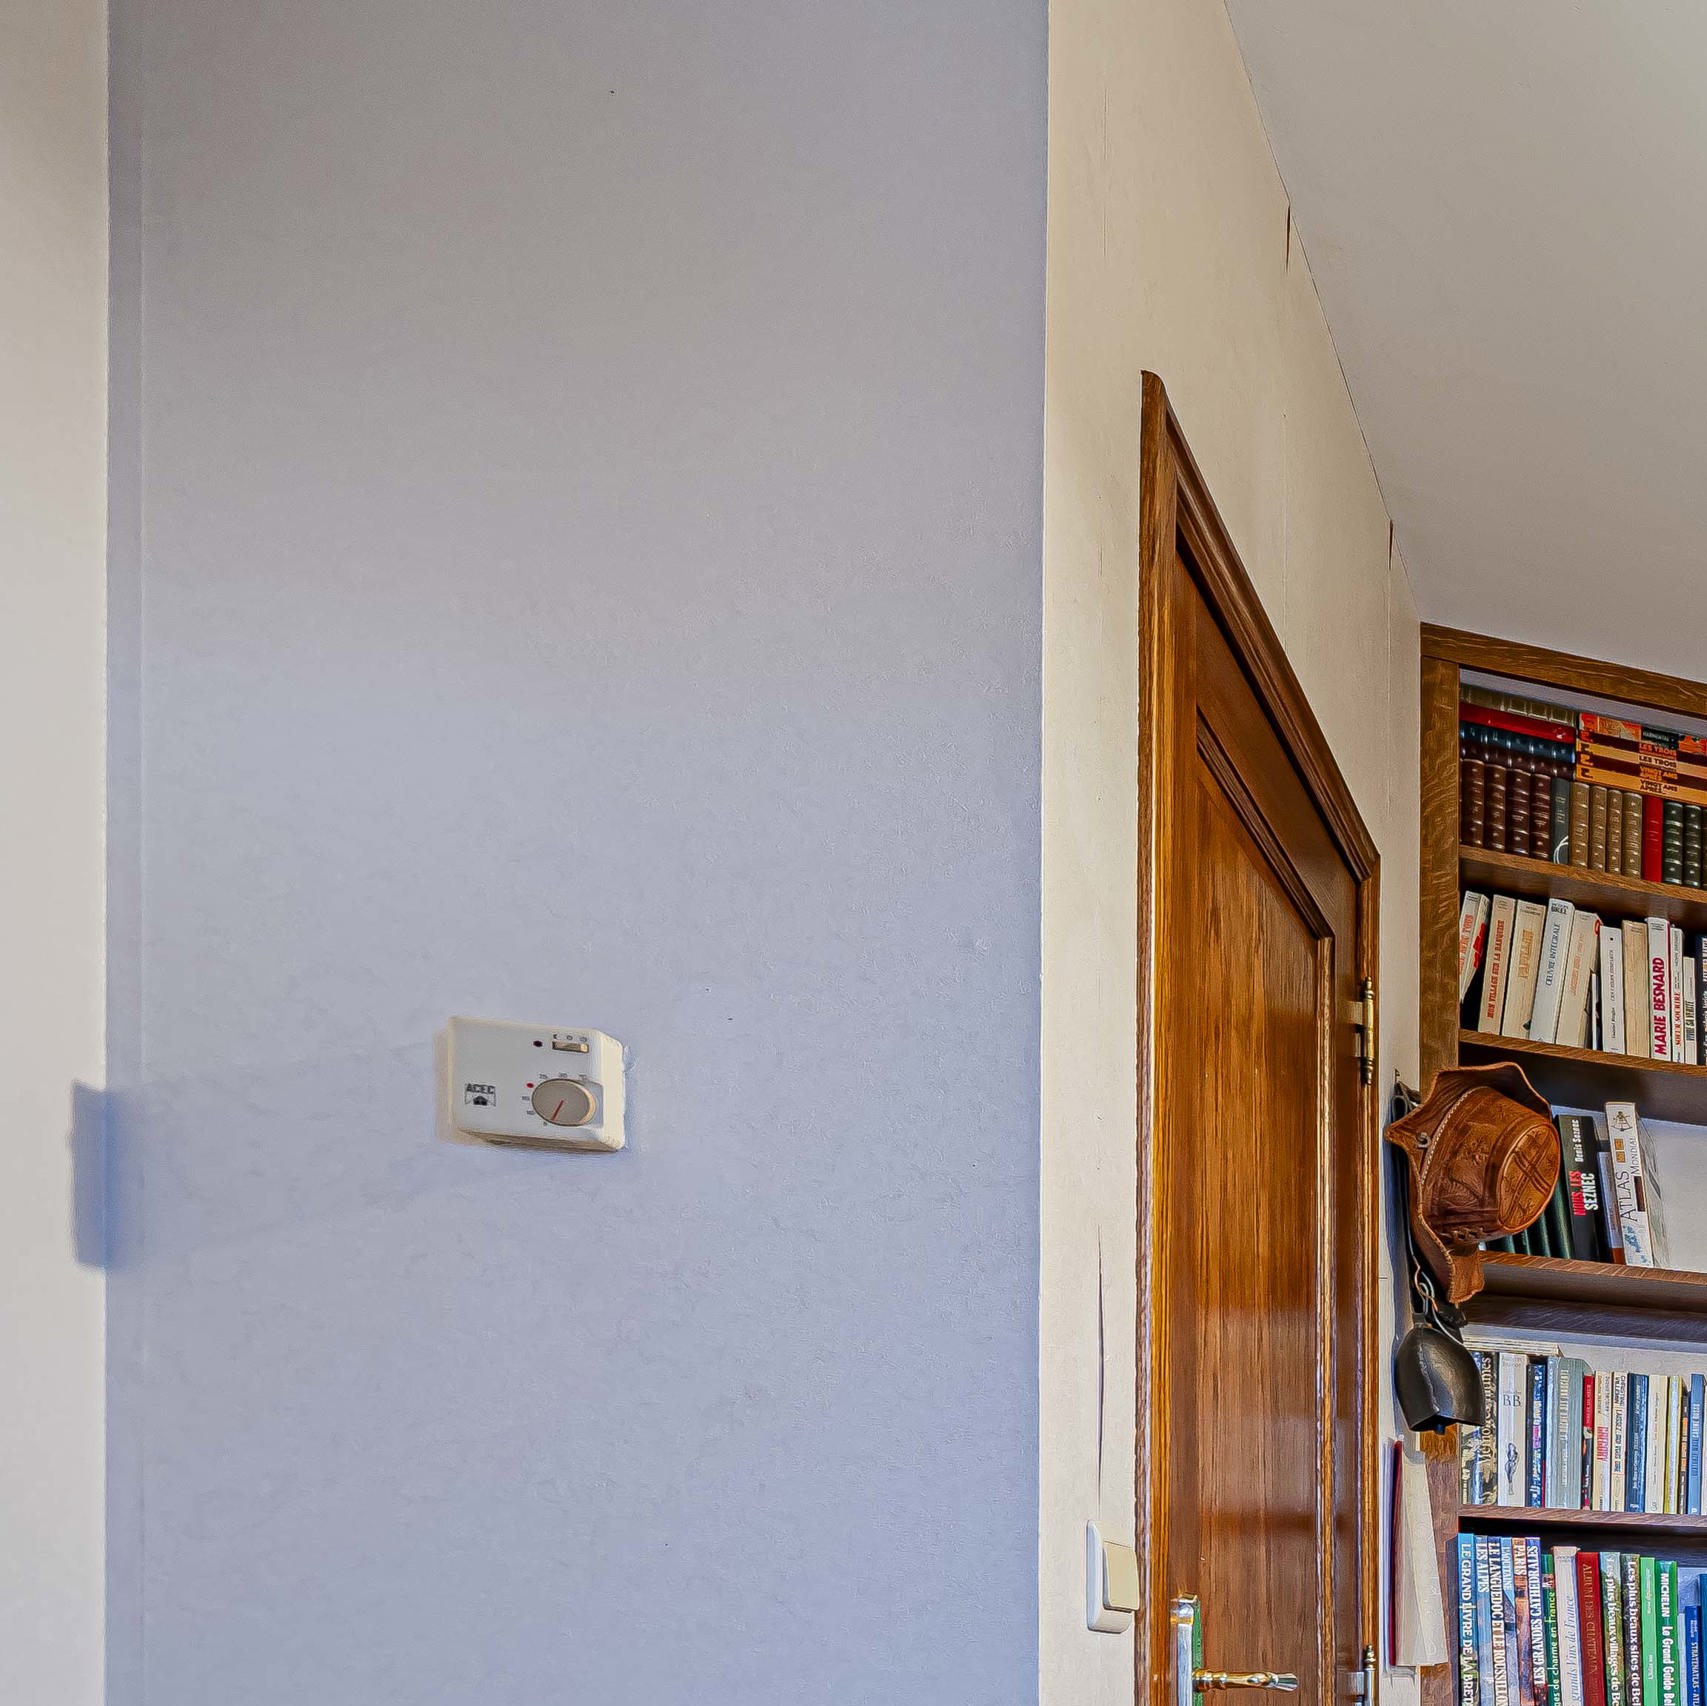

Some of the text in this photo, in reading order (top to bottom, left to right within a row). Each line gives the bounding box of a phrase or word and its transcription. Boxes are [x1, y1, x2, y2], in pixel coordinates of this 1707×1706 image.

[1652, 958, 1666, 1055] MARIE BESNARD
[466, 1083, 496, 1095] ACEC
[1574, 1145, 1584, 1162] Denis
[1582, 1173, 1598, 1210] SEZNEC
[1616, 1170, 1637, 1221] ATLAS
[1489, 1543, 1499, 1555] LE
[1514, 1545, 1525, 1575] PARIS
[1477, 1543, 1489, 1592] LES ALPES
[1628, 1562, 1638, 1580] Les
[1489, 1558, 1502, 1618] LANGUEDOC
[1603, 1579, 1617, 1600] plus
[1627, 1583, 1638, 1607] plus
[1661, 1573, 1670, 1617] MICHELIN
[1545, 1592, 1555, 1623] France
[1607, 1603, 1618, 1634] beaux
[1493, 1621, 1503, 1633] ET
[1549, 1626, 1557, 1638] en
[1630, 1609, 1640, 1642] beaux
[1663, 1626, 1674, 1636] Le
[1493, 1635, 1504, 1647] LE
[1663, 1638, 1673, 1664] Grand
[1548, 1641, 1558, 1675] charme
[1607, 1636, 1619, 1676] villages
[1630, 1645, 1640, 1670] sites
[1550, 1677, 1558, 1690] de
[1610, 1677, 1621, 1691] de
[1631, 1673, 1641, 1686] de
[1663, 1666, 1674, 1690] Guide
